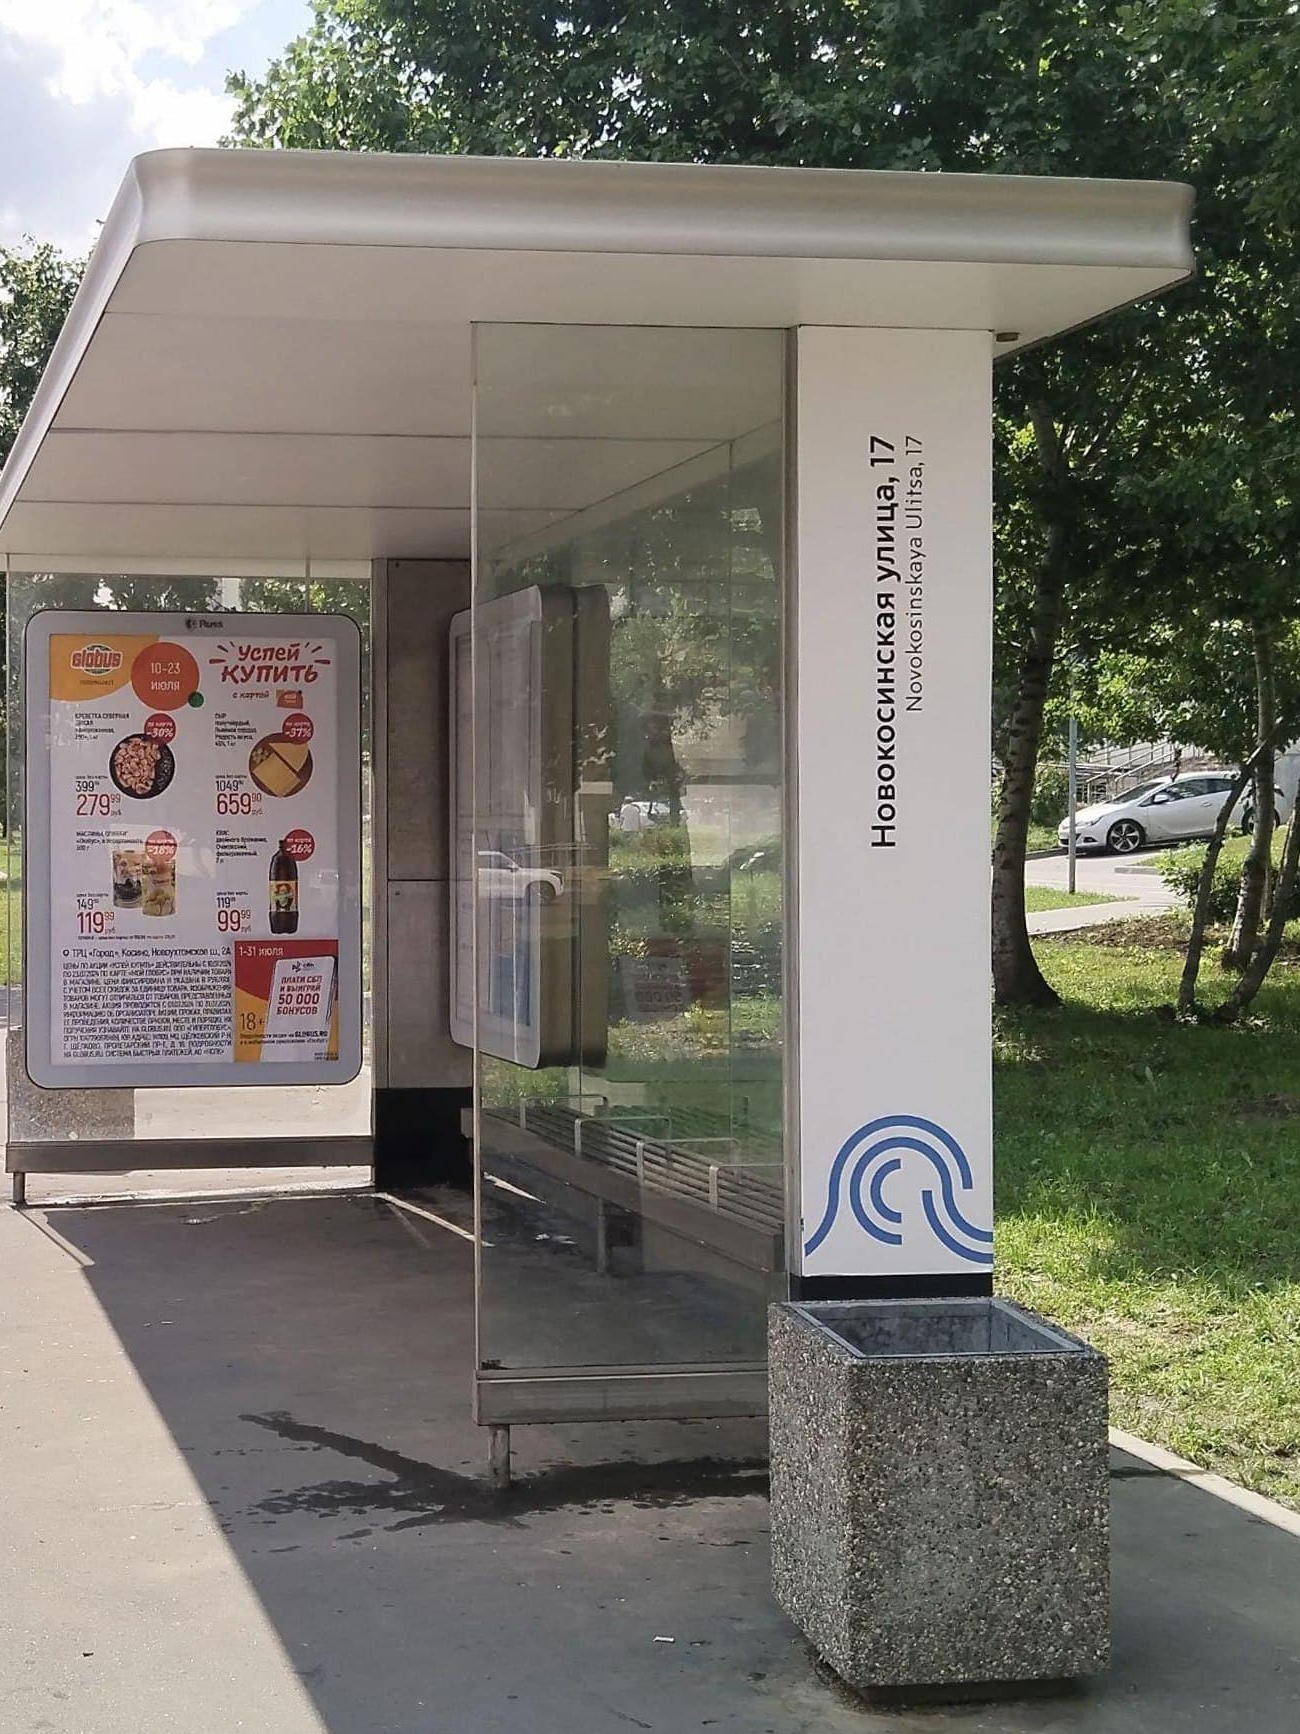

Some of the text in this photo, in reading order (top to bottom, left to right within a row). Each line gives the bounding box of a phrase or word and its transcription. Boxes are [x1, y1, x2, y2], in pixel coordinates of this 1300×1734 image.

[905, 435, 927, 712] Novokosinskaya Ulitsa, 17
[870, 435, 901, 848] Новокосинская улица, 17
[150, 662, 181, 674] 10-23
[146, 727, 174, 738] -30%
[284, 728, 311, 738] -37%
[76, 780, 94, 792] 399
[216, 780, 238, 791] 1049
[77, 794, 110, 816] 279
[217, 793, 251, 815] 659
[286, 843, 313, 854] -16%
[77, 898, 94, 910] 149
[77, 911, 104, 934] 119
[218, 910, 241, 932] 99
[239, 945, 256, 957] 1-31
[277, 992, 320, 1005] 50 000
[276, 1006, 318, 1015] БОНУСОВ
